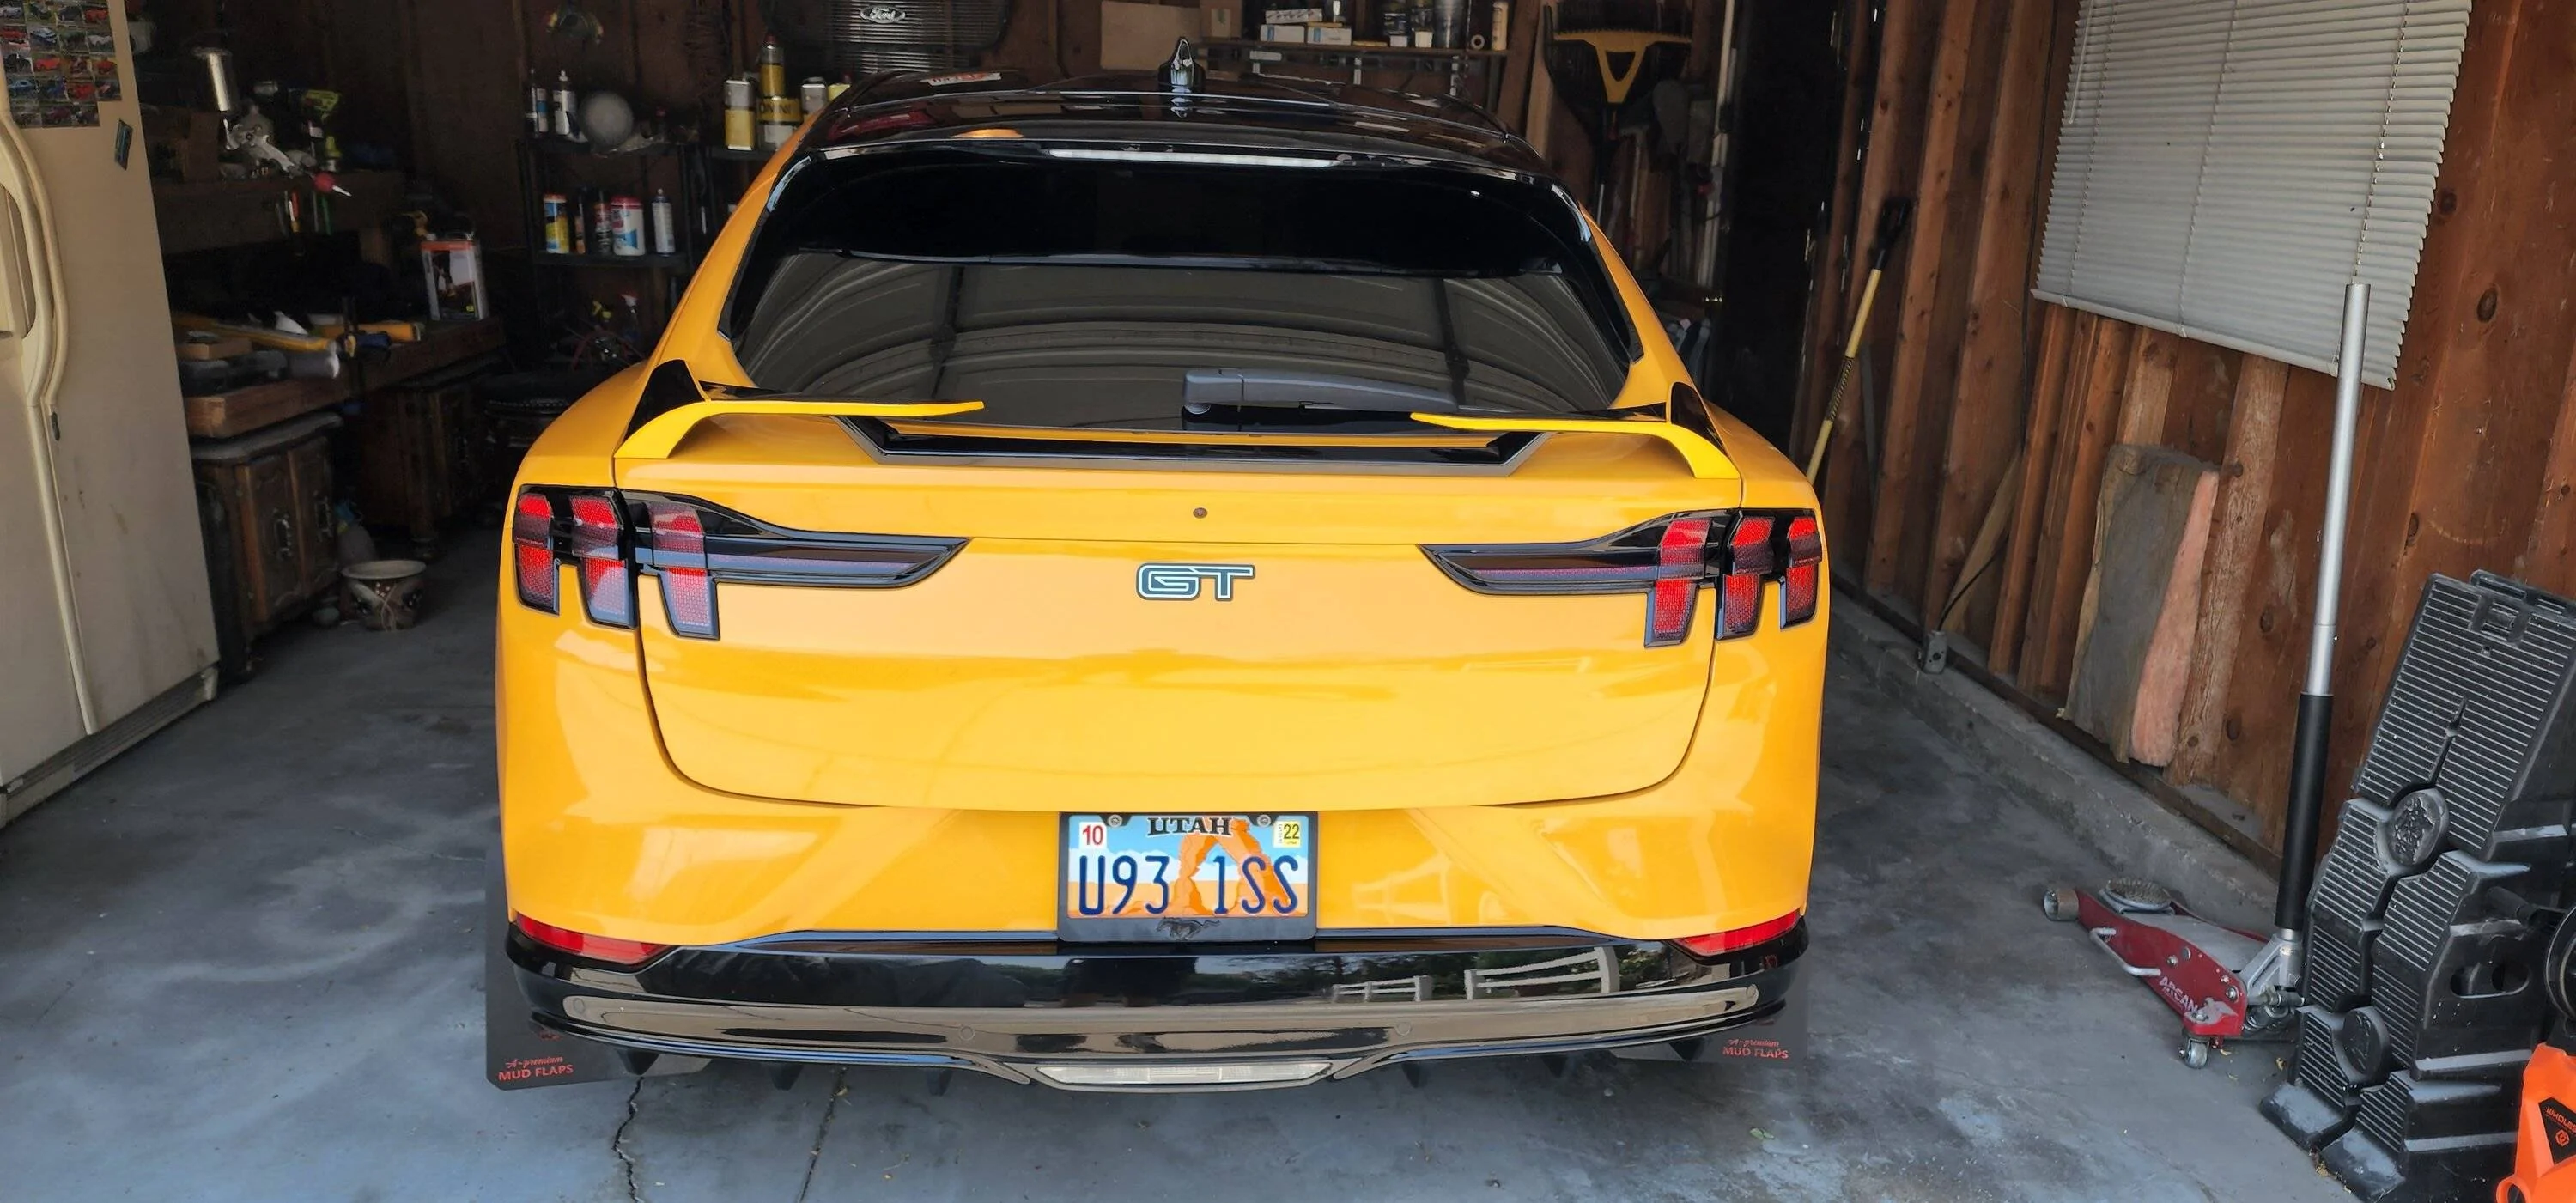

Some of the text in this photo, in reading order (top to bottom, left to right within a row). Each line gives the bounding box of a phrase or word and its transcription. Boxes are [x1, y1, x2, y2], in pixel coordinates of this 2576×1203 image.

[1136, 562, 1256, 602] GT
[1082, 824, 1104, 846] 10
[1147, 817, 1231, 836] UTAH
[1283, 823, 1300, 840] 22
[1078, 855, 1299, 915] U93 1SS
[2158, 975, 2199, 1013] ARCAN
[1722, 1046, 1789, 1060] MUD FLAPS
[498, 1064, 574, 1081] MUD FLAPS
